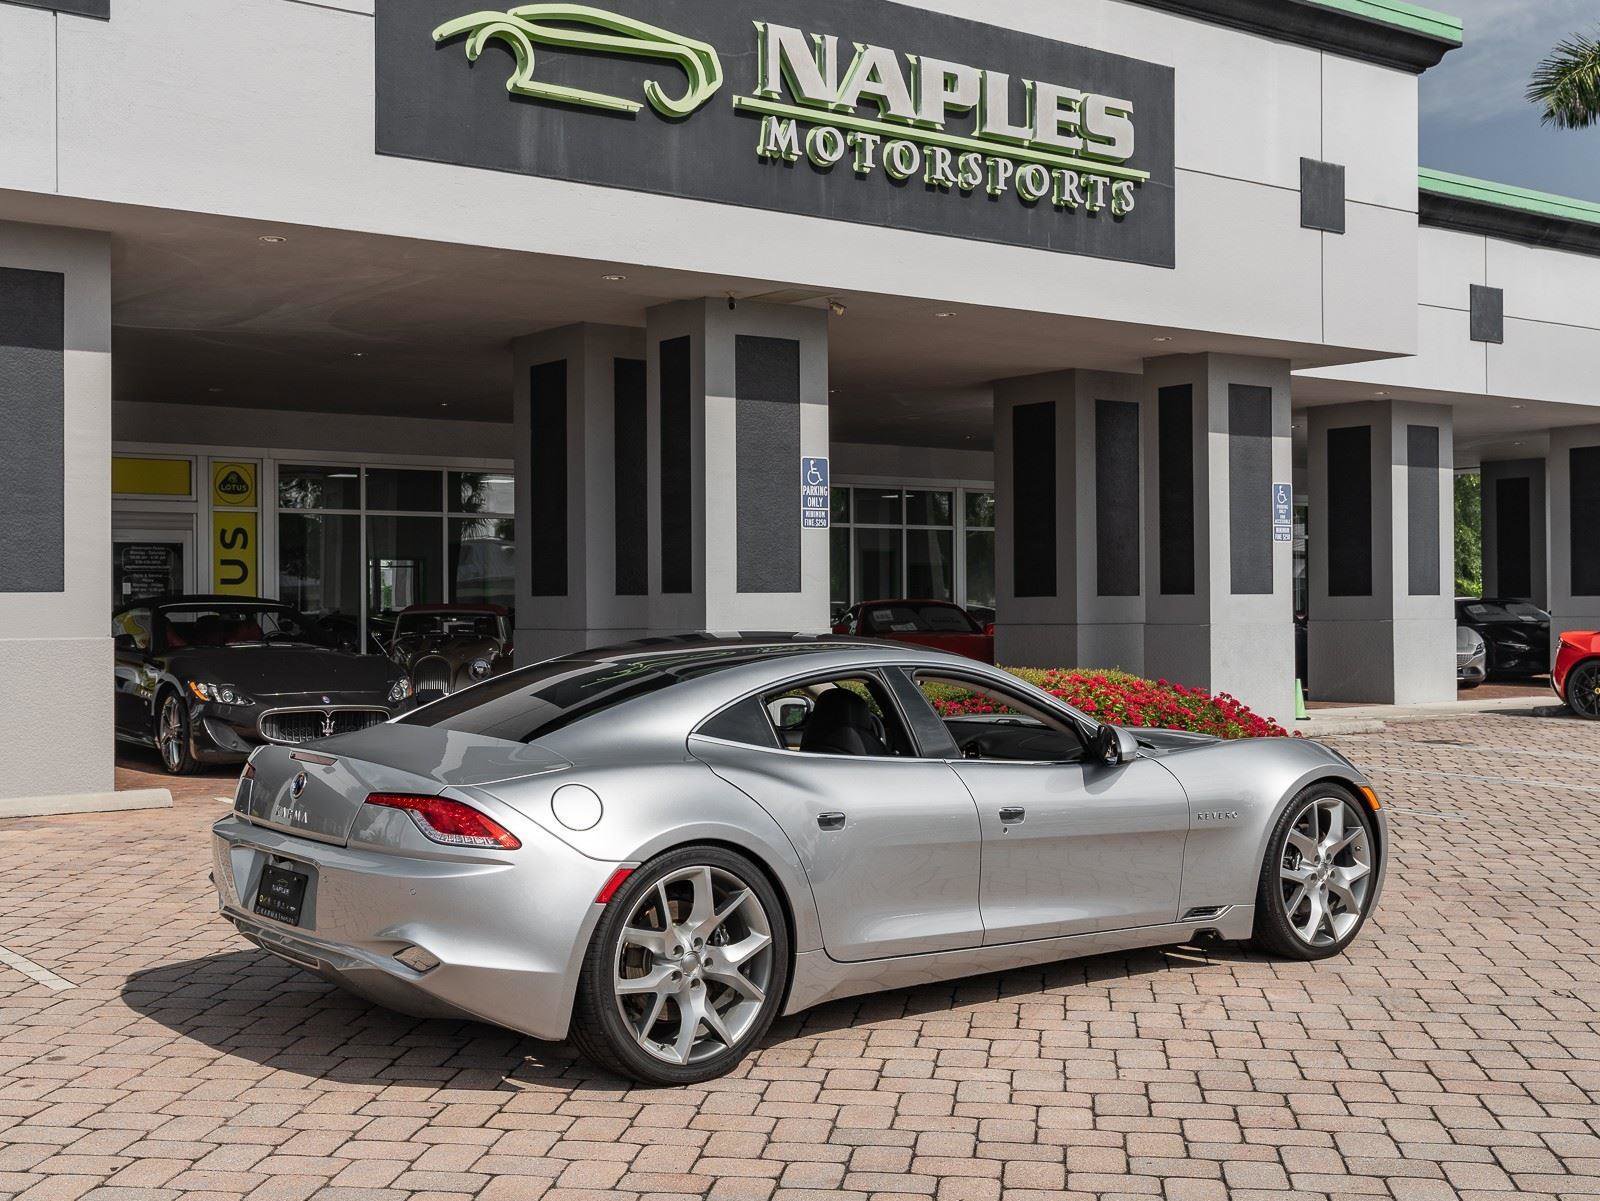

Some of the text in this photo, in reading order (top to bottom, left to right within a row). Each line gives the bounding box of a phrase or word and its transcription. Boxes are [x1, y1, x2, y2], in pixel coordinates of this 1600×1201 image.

[752, 20, 1135, 164] NAPLES
[757, 116, 1135, 216] MOTORSPORTS
[221, 484, 247, 492] LOTUS
[803, 486, 827, 496] PARKING
[807, 497, 823, 507] ONLY
[1197, 811, 1238, 820] REVERO
